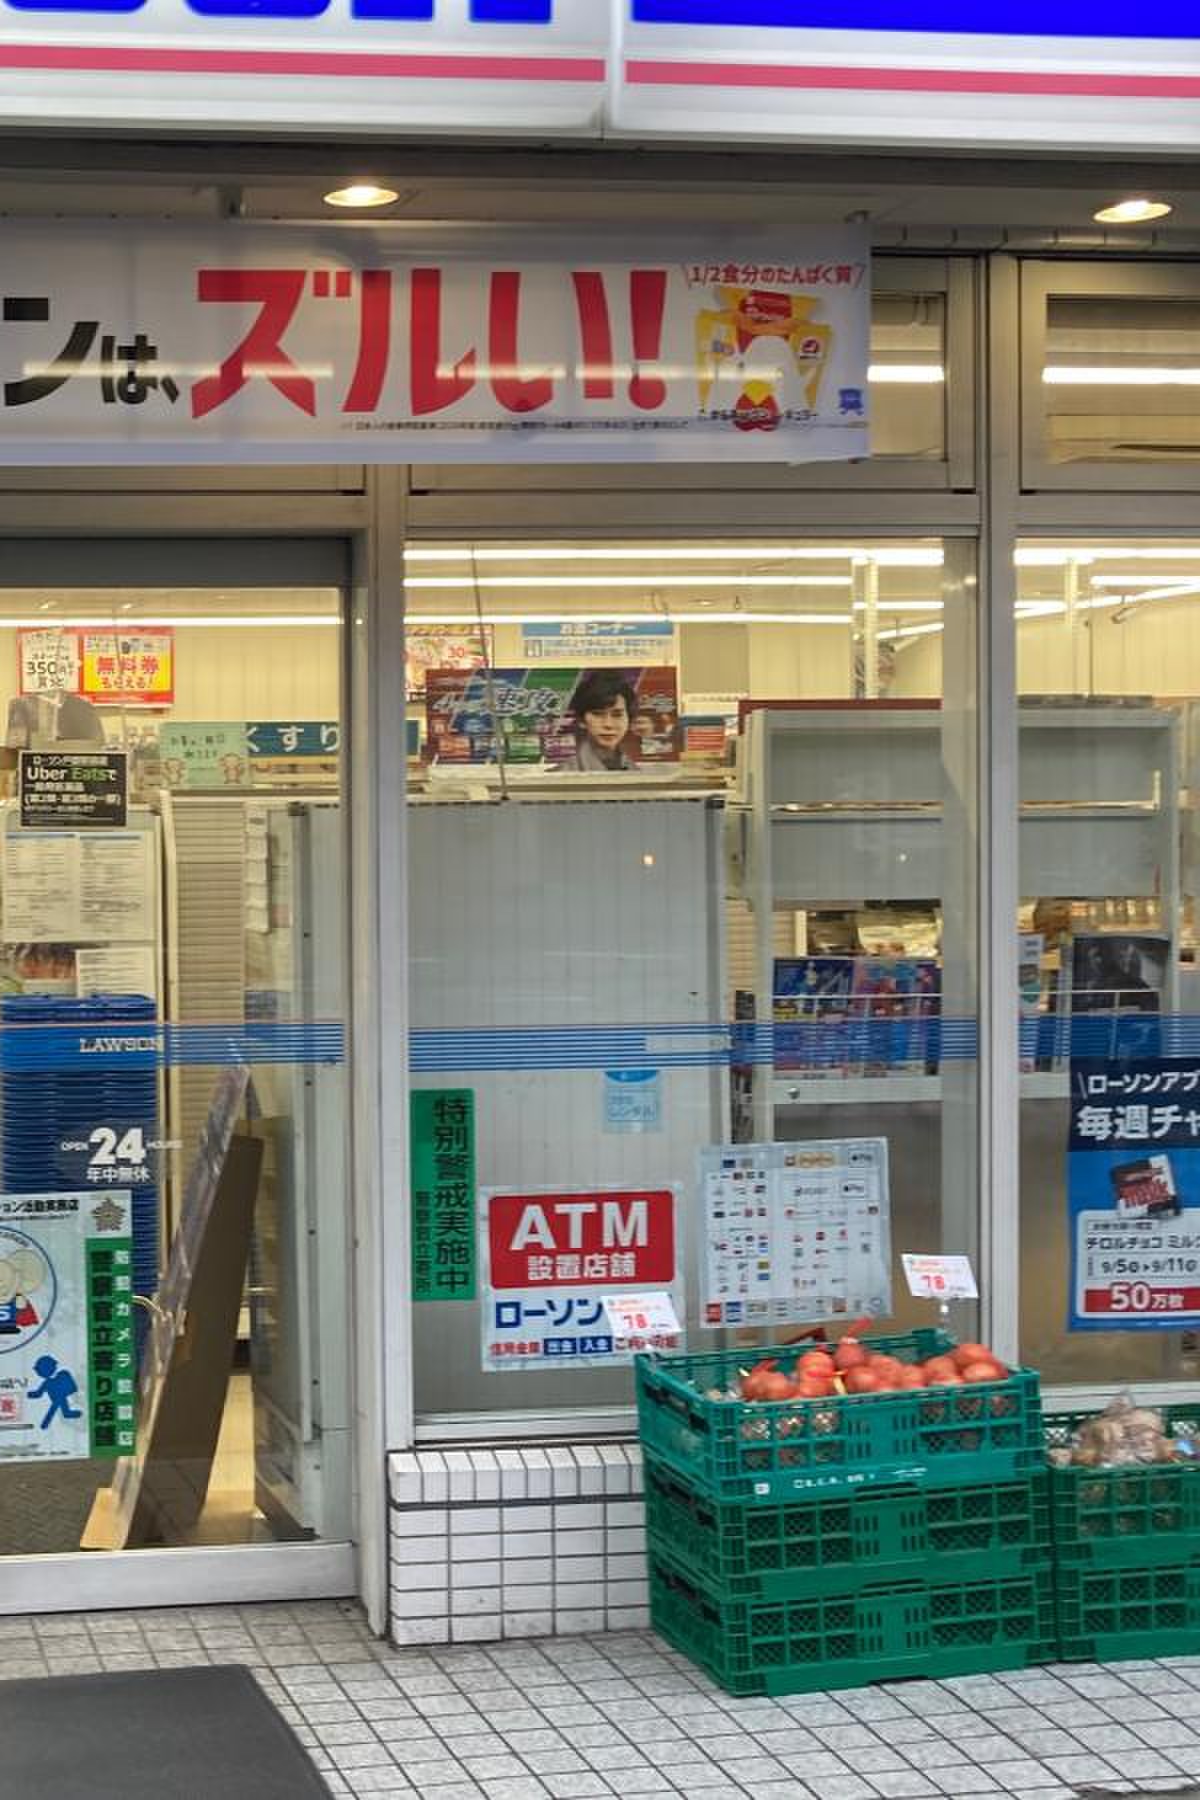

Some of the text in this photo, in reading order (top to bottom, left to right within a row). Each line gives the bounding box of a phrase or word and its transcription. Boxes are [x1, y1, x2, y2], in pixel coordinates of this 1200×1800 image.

[246, 725, 339, 752] くすり
[27, 766, 67, 780] Uber
[89, 1128, 146, 1165] 24
[87, 1166, 150, 1183] 年中無休
[510, 1201, 648, 1251] ATM
[528, 1252, 636, 1281] 設置店舗
